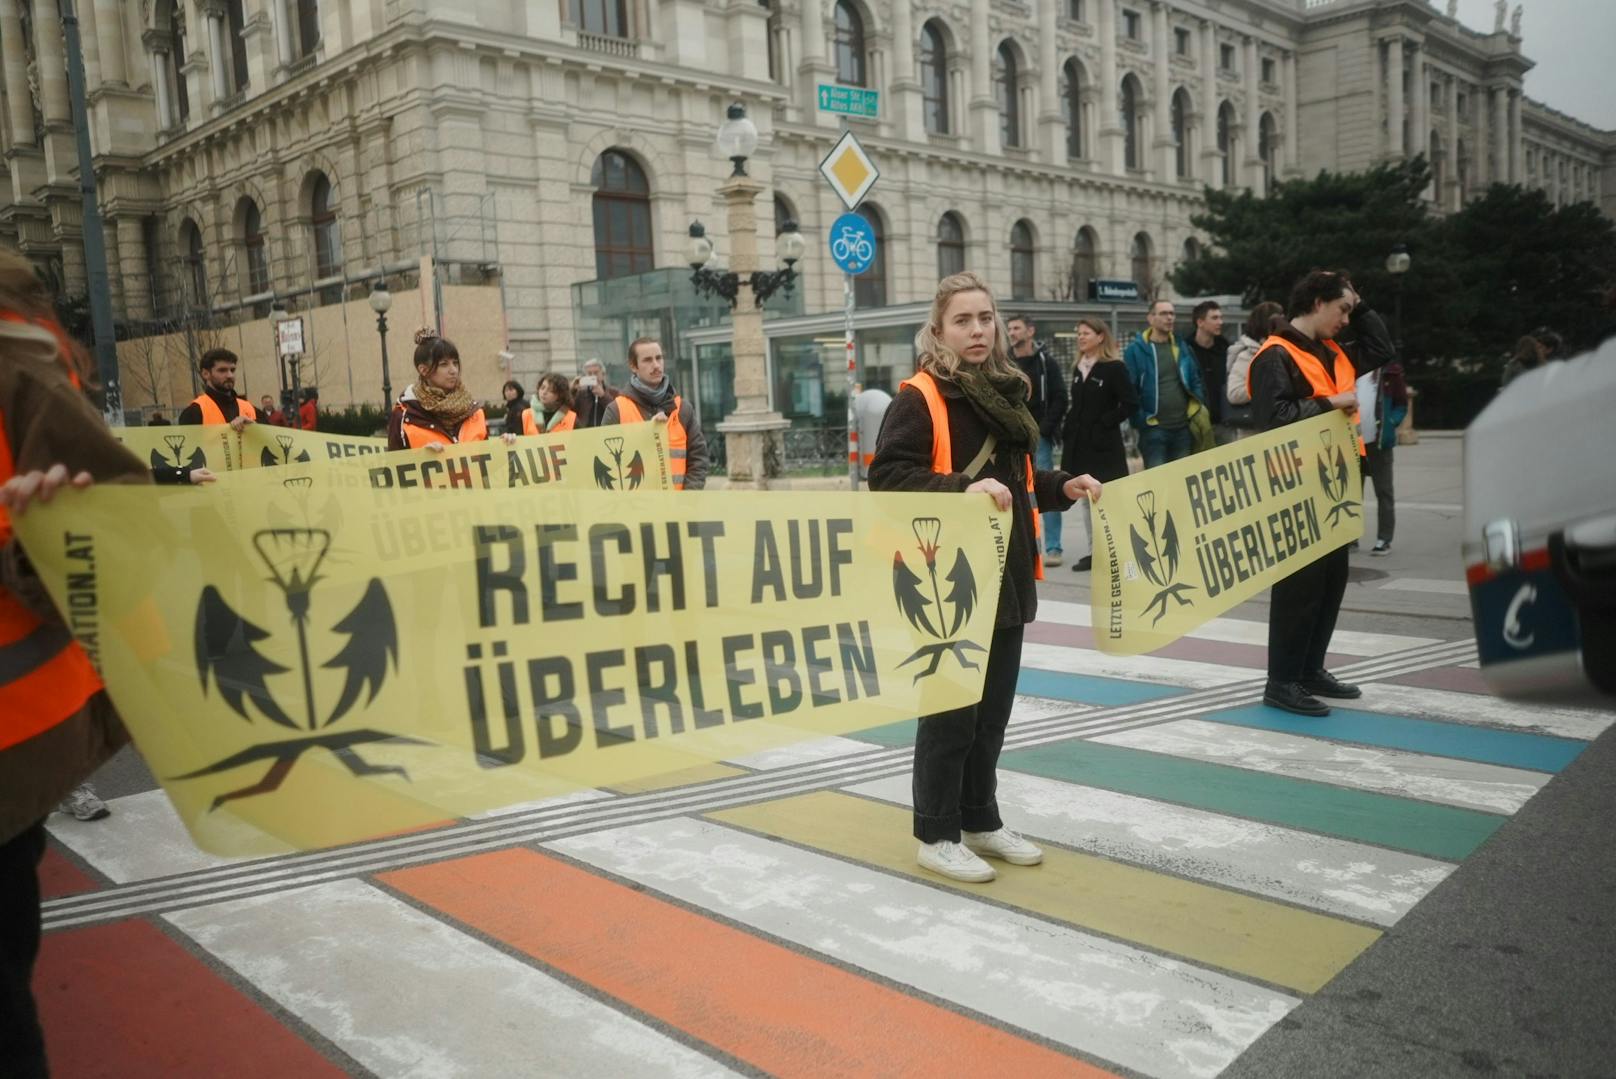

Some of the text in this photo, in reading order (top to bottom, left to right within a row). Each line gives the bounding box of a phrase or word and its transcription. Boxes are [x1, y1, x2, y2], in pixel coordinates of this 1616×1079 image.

[369, 453, 491, 499] RECHT
[507, 443, 568, 488] AUF
[1184, 454, 1263, 529] RECHT
[1263, 440, 1304, 497] AUF
[472, 517, 854, 629] RECHT AUF
[1097, 508, 1122, 640] LETZTE GENERATION.AT
[1194, 496, 1322, 599] ÜBERLEBEN
[464, 620, 882, 770] ÜBERLEBEN
